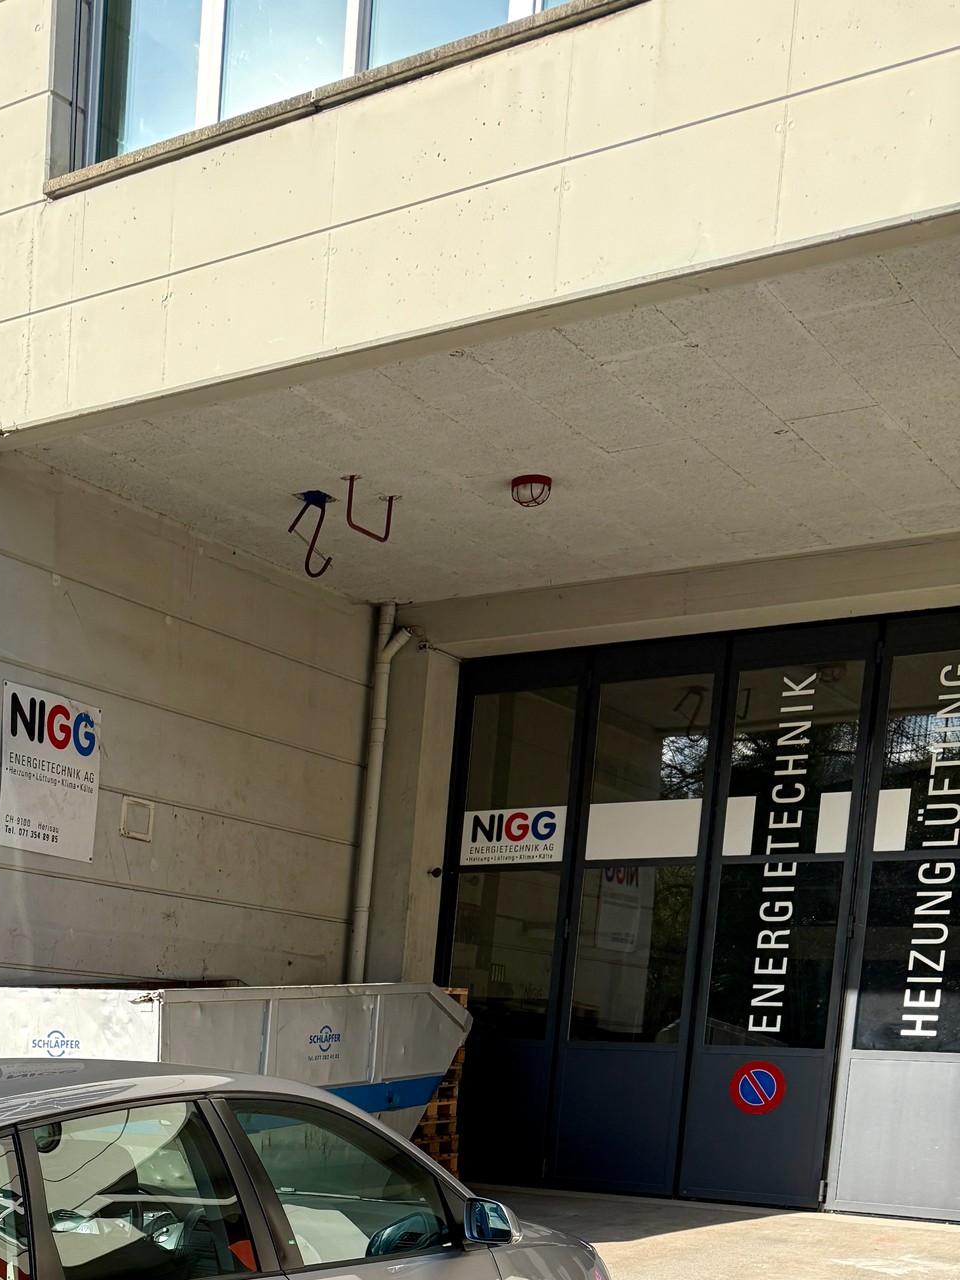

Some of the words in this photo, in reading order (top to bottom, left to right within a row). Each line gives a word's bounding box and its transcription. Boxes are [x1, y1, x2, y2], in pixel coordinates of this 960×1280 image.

[10, 692, 96, 757] NIGG
[9, 752, 81, 780] ENERGIETECHNIK
[84, 771, 95, 784] AG
[4, 824, 16, 835] Tel.
[18, 827, 29, 838] 071
[37, 821, 60, 834] Herisau
[471, 810, 557, 843] NIGG
[469, 844, 539, 854] ENERGIETECHNIK
[543, 843, 554, 852] AG
[748, 672, 818, 1034] ENERGIETECHNIK
[900, 862, 955, 1037] HEIZUNG
[32, 1036, 80, 1049] SCHLÄPFER
[309, 1031, 341, 1044] SCHLÄPFER
